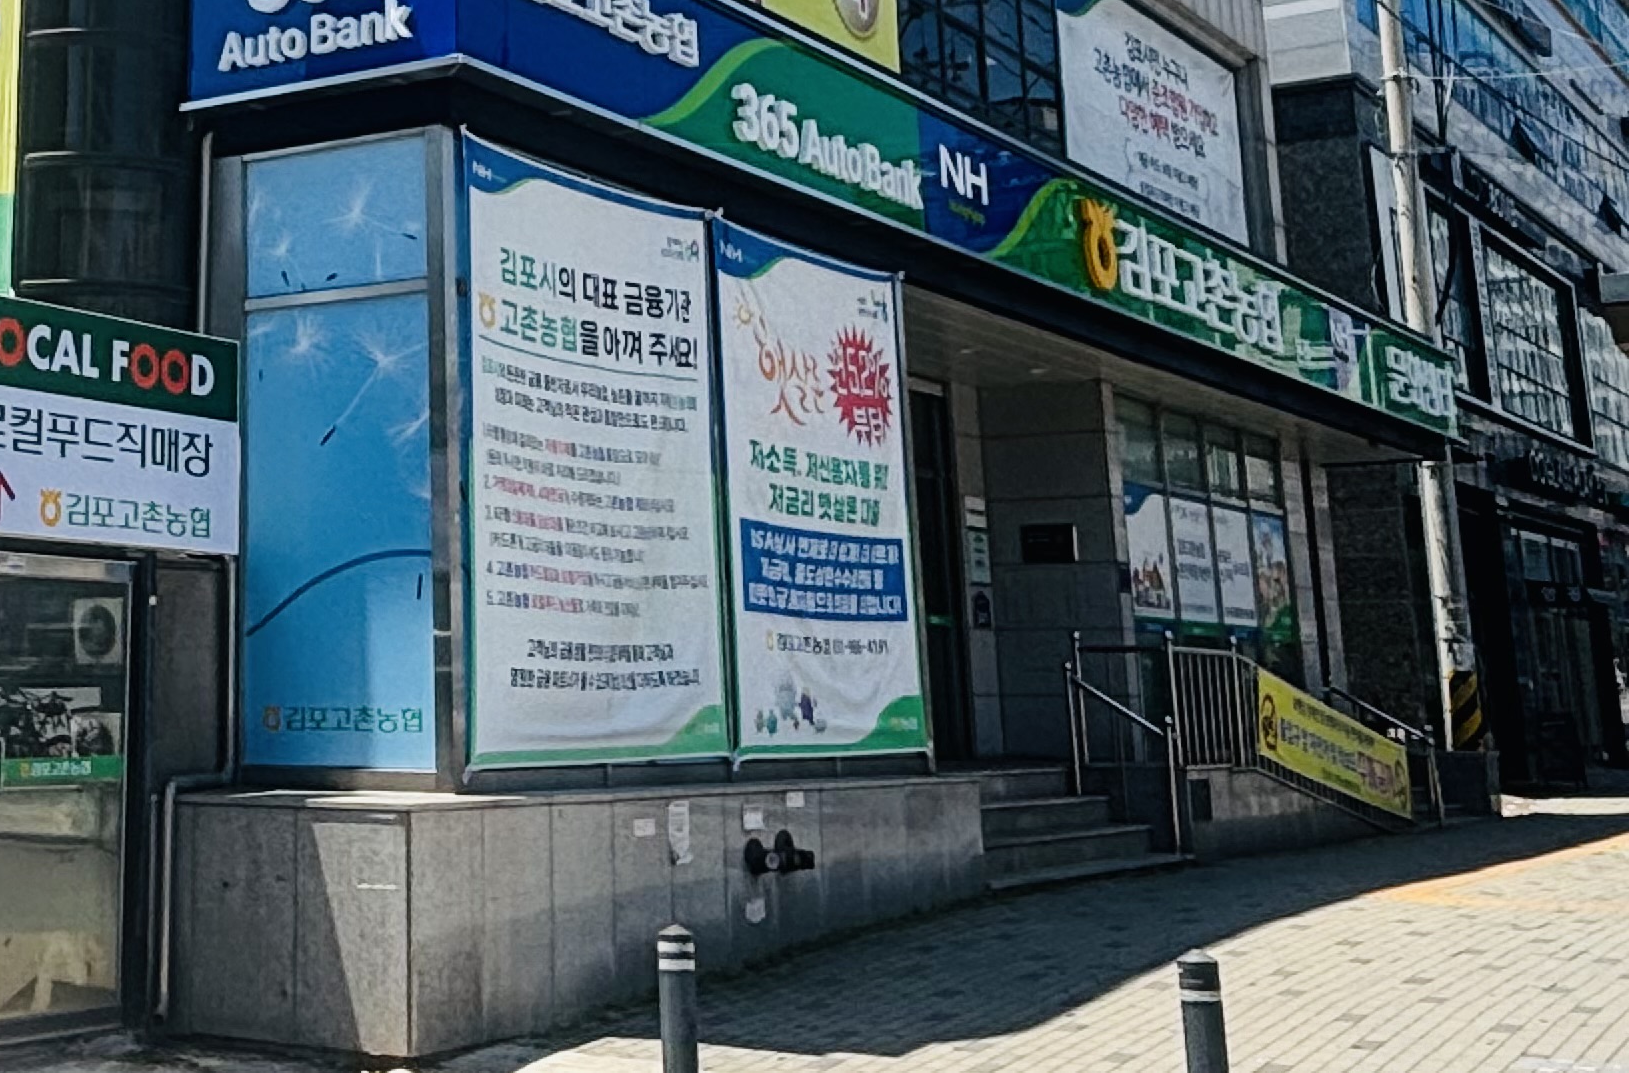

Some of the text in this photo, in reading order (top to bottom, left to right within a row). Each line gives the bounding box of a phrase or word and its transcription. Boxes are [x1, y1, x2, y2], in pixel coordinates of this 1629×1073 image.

[731, 83, 800, 158] 365
[472, 160, 492, 181] NH
[939, 144, 989, 205] NH
[720, 240, 743, 263] NH
[500, 247, 691, 323] 김포시의 대표 금융기관
[1116, 217, 1284, 354] 김포고촌농협
[500, 299, 600, 357] 고촌농협을
[603, 326, 642, 365] 아껴
[111, 339, 215, 397] FOOD
[66, 493, 211, 539] 김포고촌농협
[769, 483, 814, 517] 저금리
[284, 705, 423, 733] 김포고촌농협
